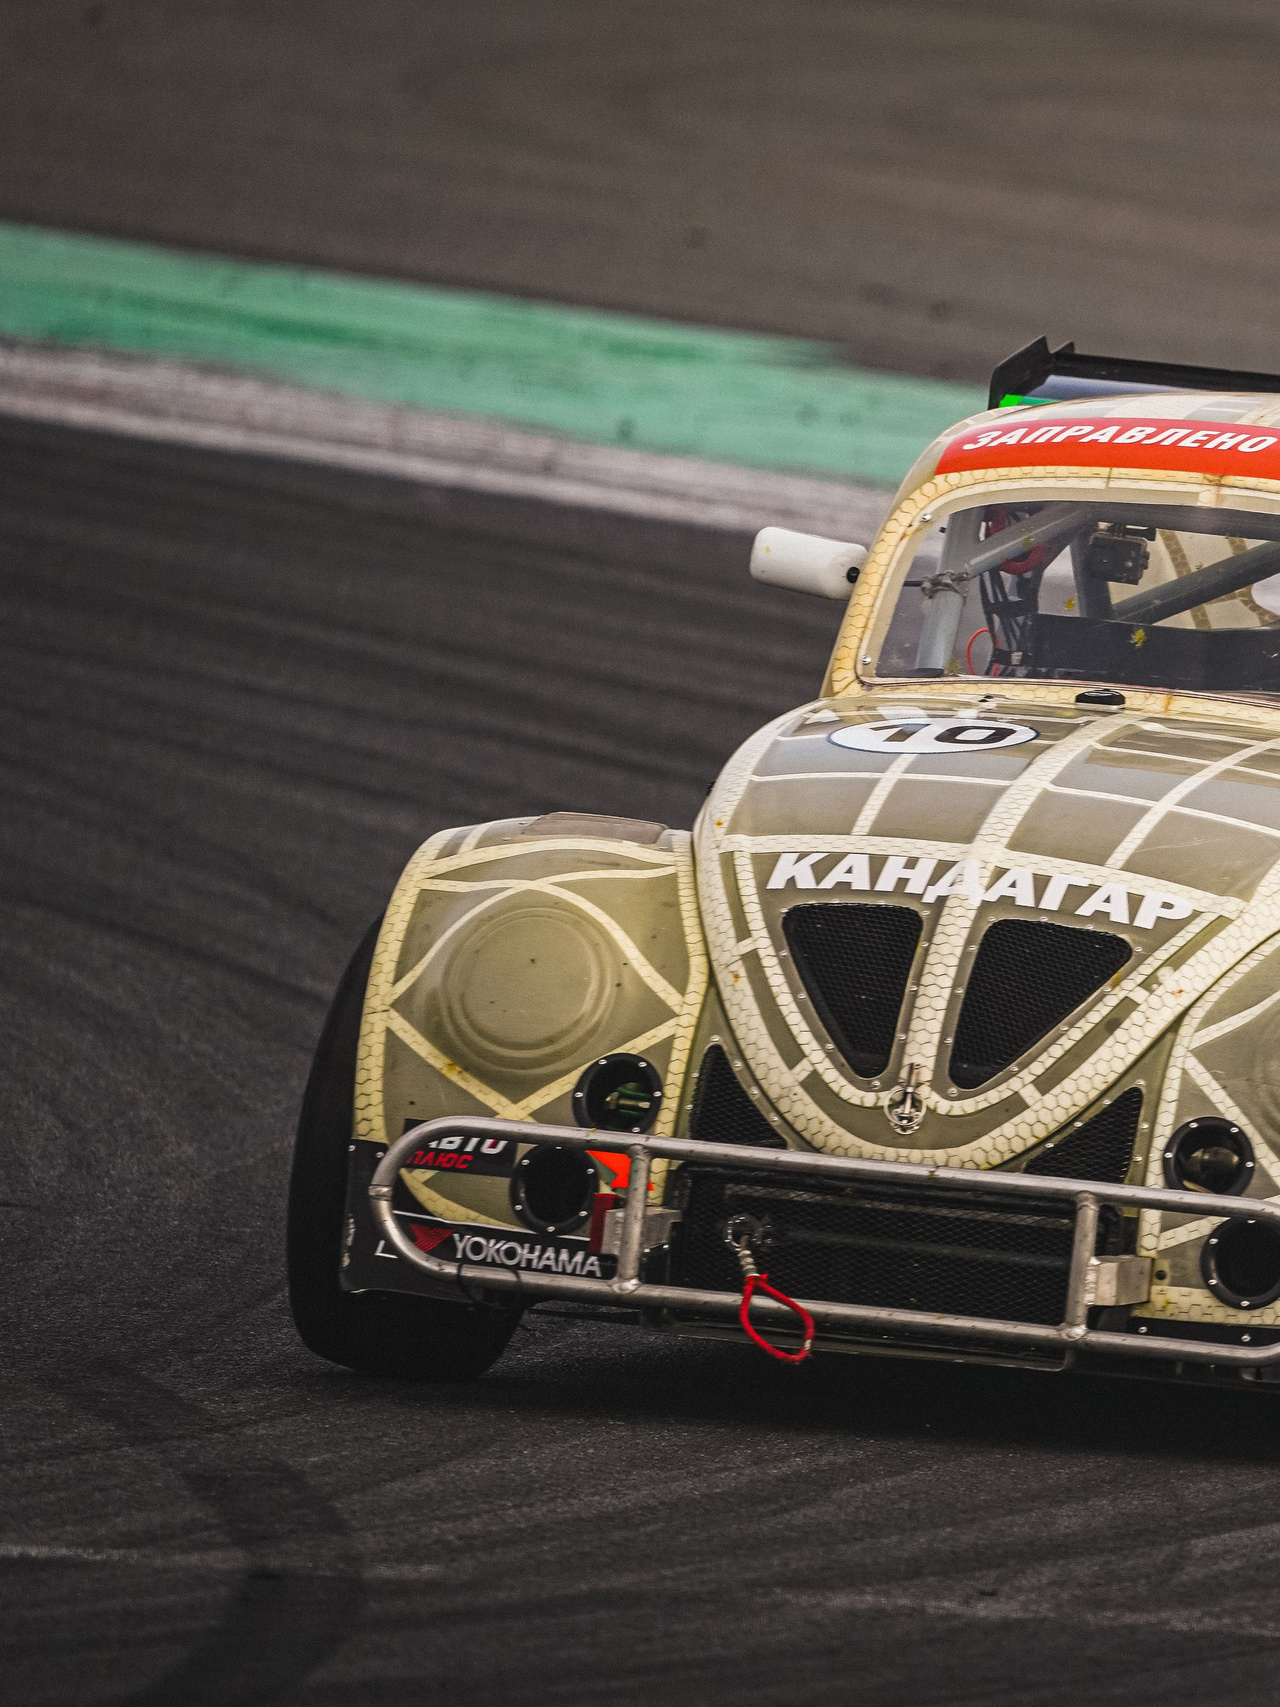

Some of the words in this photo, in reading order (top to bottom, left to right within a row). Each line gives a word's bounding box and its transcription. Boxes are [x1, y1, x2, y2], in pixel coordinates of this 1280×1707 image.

[962, 423, 1279, 453] ЗАПРАВЛЕНО
[868, 723, 1018, 745] 10
[766, 853, 1195, 931] КАНДАГАР
[452, 1233, 602, 1277] YOKOHAMA
